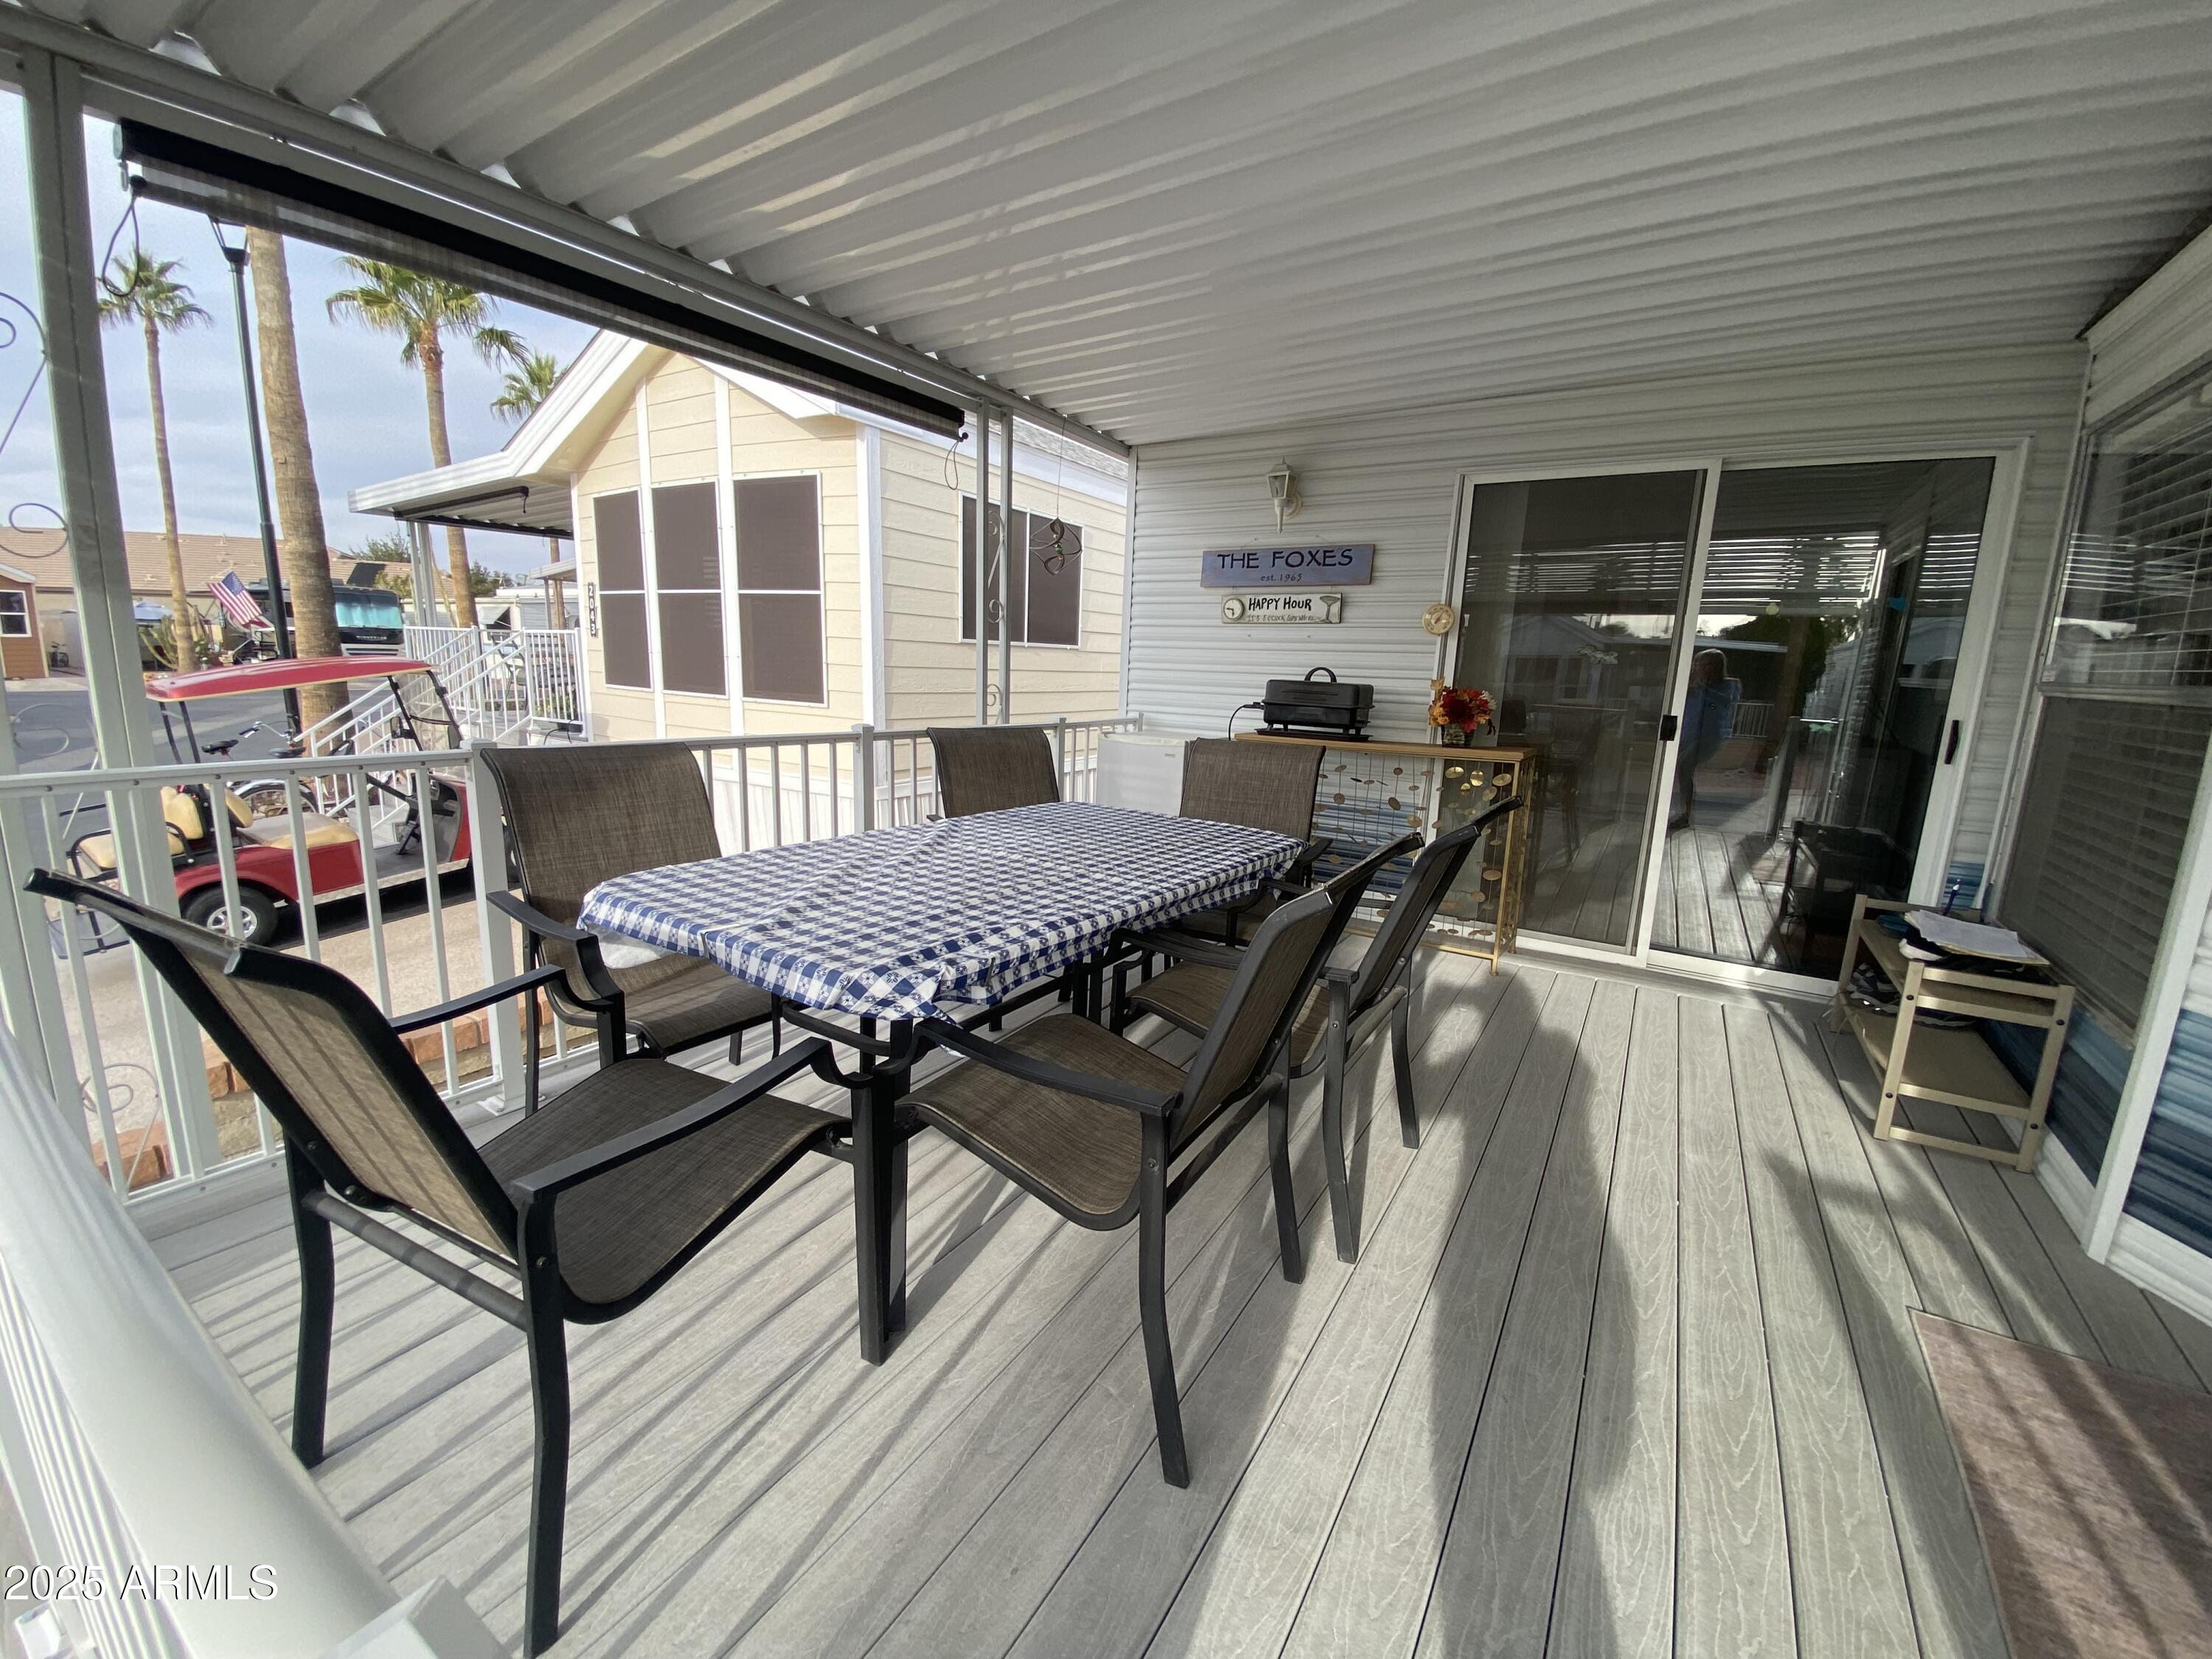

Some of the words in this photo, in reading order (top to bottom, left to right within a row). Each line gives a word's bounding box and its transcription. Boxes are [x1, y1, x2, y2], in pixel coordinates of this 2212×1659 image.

[1217, 552, 1259, 569] THE
[1271, 548, 1354, 568] FOXES
[1279, 573, 1303, 582] 1965
[1248, 597, 1281, 611] HAPPY
[1283, 596, 1312, 611] HOUR
